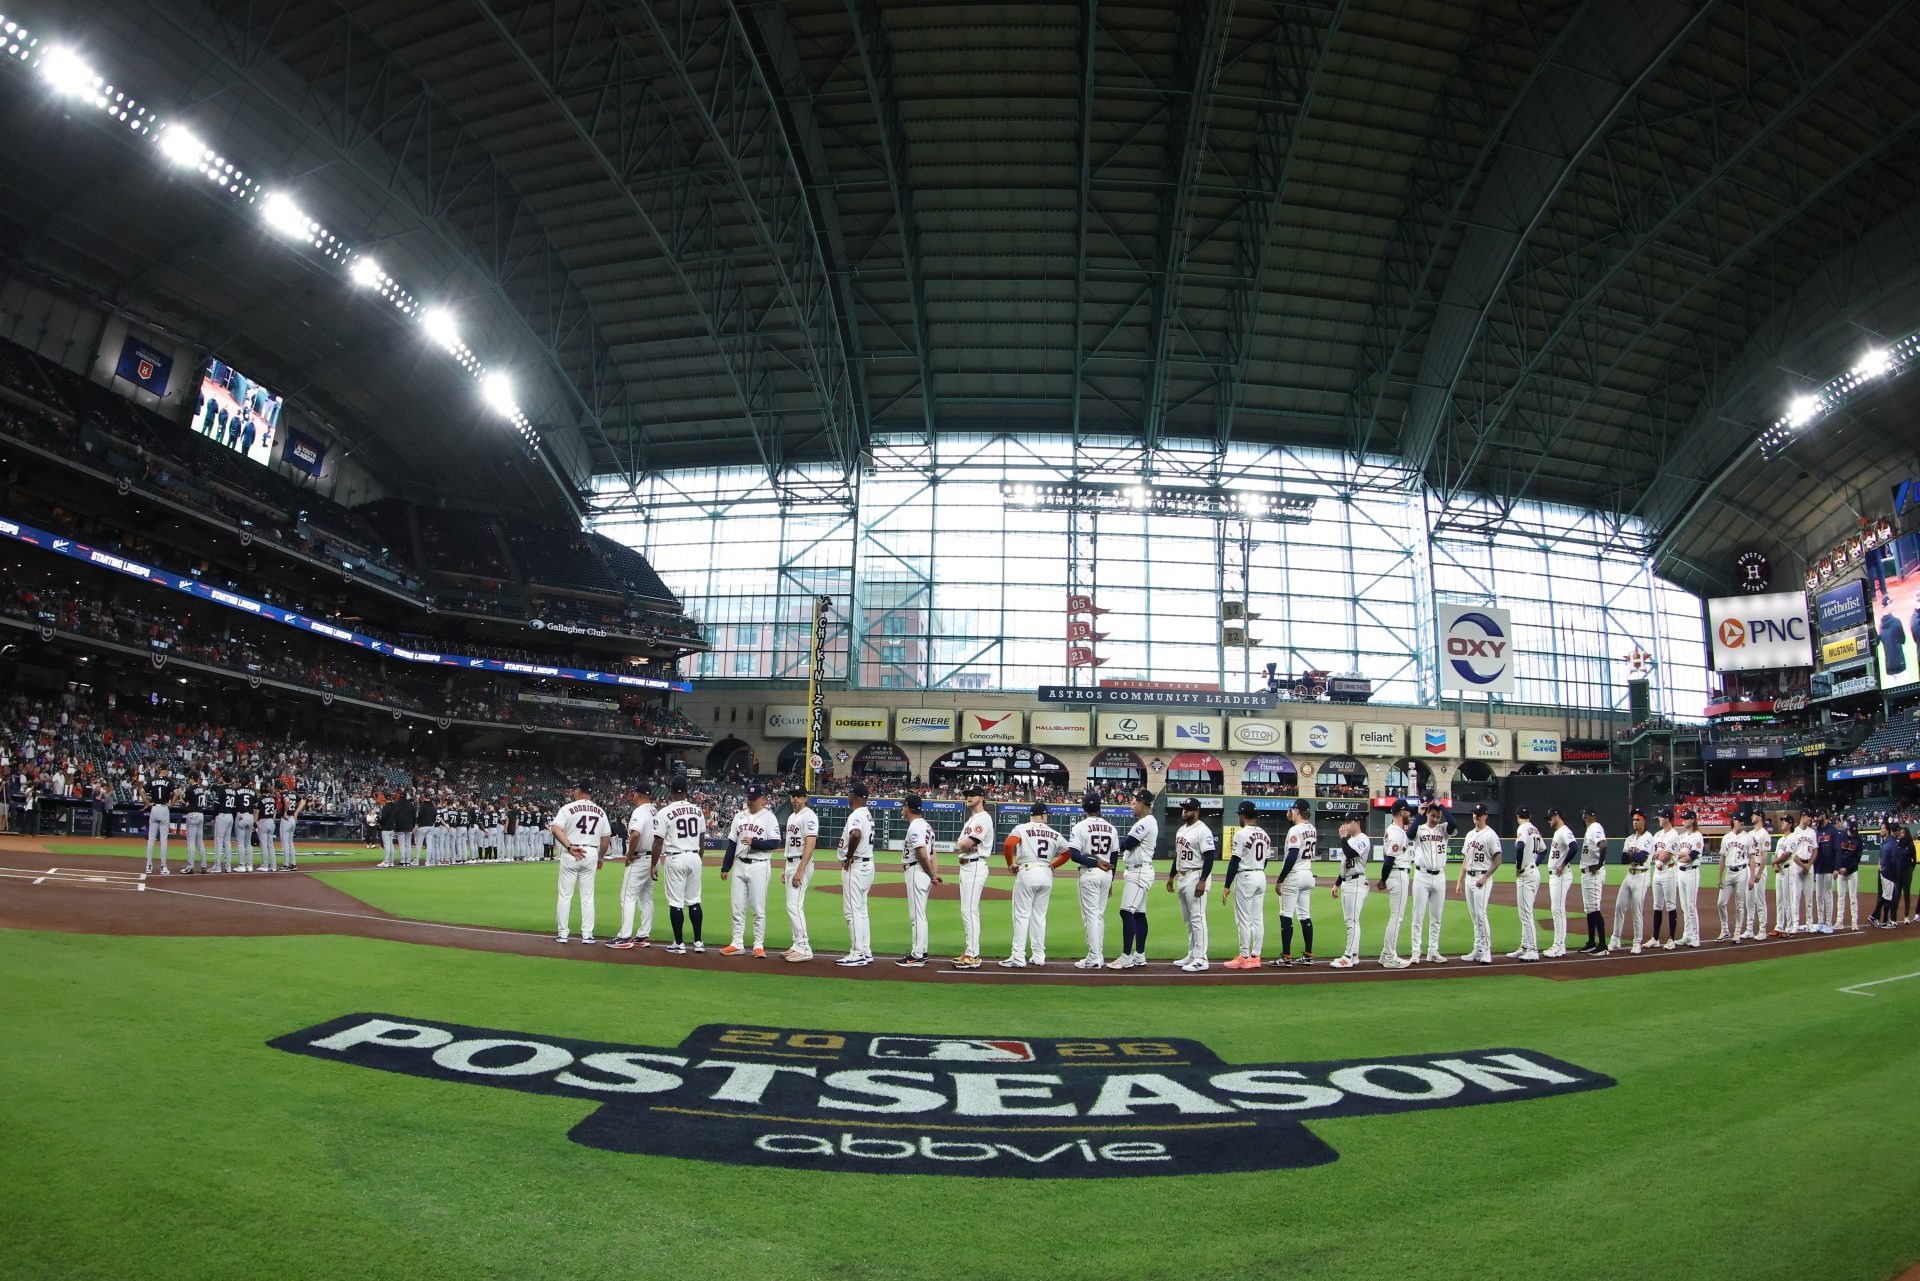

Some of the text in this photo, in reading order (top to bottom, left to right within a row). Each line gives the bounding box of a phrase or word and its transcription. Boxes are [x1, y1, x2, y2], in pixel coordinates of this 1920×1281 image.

[1738, 552, 1766, 565] HOUSTON
[123, 561, 150, 578] LINEUPS
[1746, 564, 1760, 580] H
[1742, 580, 1768, 591] ASTROS
[1072, 599, 1086, 610] 05
[1227, 605, 1239, 615] 17
[1822, 596, 1860, 618] Methodist
[547, 622, 606, 638] Gallagher Club
[1073, 626, 1086, 636] 19
[1747, 617, 1805, 644] PNC
[1227, 632, 1239, 642] 22
[1447, 638, 1506, 658] OXY
[1828, 643, 1854, 658] MUSTANG
[1072, 650, 1084, 660] 21
[504, 663, 558, 676] STARTING LINEUPS
[618, 677, 669, 688] STARTING LINEUPS
[812, 617, 827, 754] CHIKIN IZ FAIR
[1838, 677, 1869, 690] HARGROVE
[1048, 690, 1267, 705] ASTROS COMMUNITY LEADERS
[781, 718, 808, 728] CALPIN
[1190, 722, 1210, 735] slb
[1240, 728, 1272, 741] COTTON
[1360, 732, 1394, 742] reliant
[1533, 739, 1558, 752] LNG
[1798, 742, 1826, 752] PLUCKERS
[1564, 748, 1610, 760] Budweiser
[1329, 761, 1356, 770] SPACE CITY
[158, 787, 162, 799] 1
[226, 796, 234, 808] 20
[244, 796, 250, 806] 5
[265, 804, 275, 814] 23
[570, 805, 604, 818] RODRIGUEZ
[576, 816, 600, 835] 47
[676, 818, 698, 838] 90
[1088, 825, 1112, 833] JAVIER
[1026, 827, 1058, 840] VÁZQUEZ
[790, 836, 801, 846] 35
[1091, 836, 1112, 854] 53
[1038, 840, 1048, 858] 2
[1181, 850, 1192, 860] 30
[1256, 842, 1264, 862] 0
[1552, 851, 1560, 860] 38
[1474, 853, 1484, 862] 58
[1738, 852, 1746, 860] 74
[719, 1030, 1178, 1056] 20 26
[308, 1019, 1582, 1117] POSTSEASON
[754, 1132, 1173, 1164] abbvie
